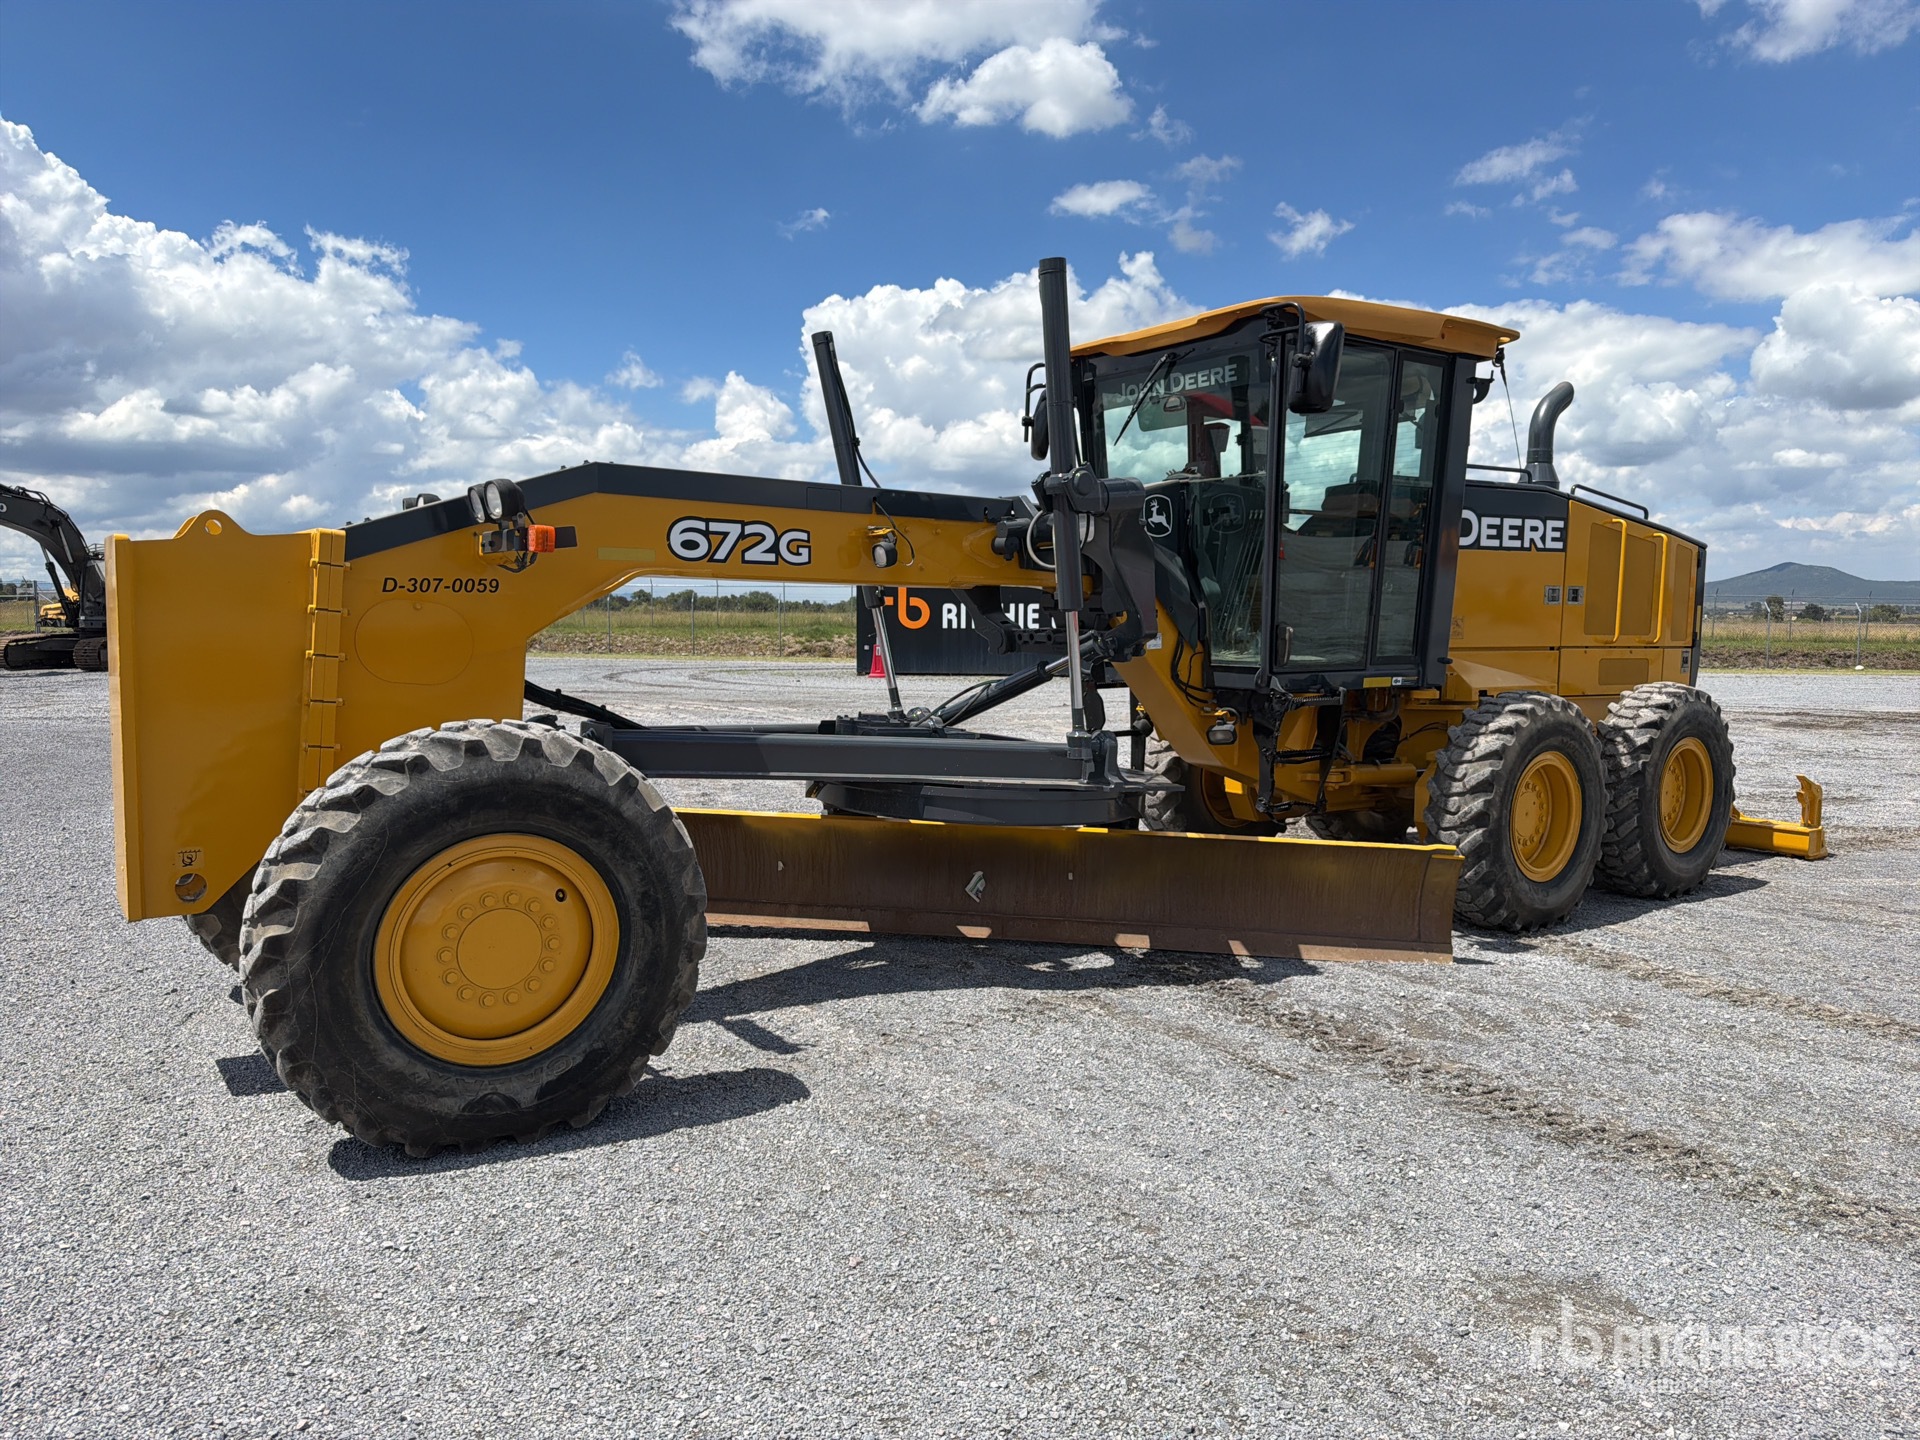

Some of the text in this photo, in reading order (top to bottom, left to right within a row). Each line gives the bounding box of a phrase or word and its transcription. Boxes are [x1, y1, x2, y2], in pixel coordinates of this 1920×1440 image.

[1170, 363, 1238, 395] DEERE
[666, 515, 811, 566] 672G
[1459, 509, 1564, 549] DEERE
[382, 577, 499, 593] D-307-0059
[942, 602, 1040, 629] RIHIE
